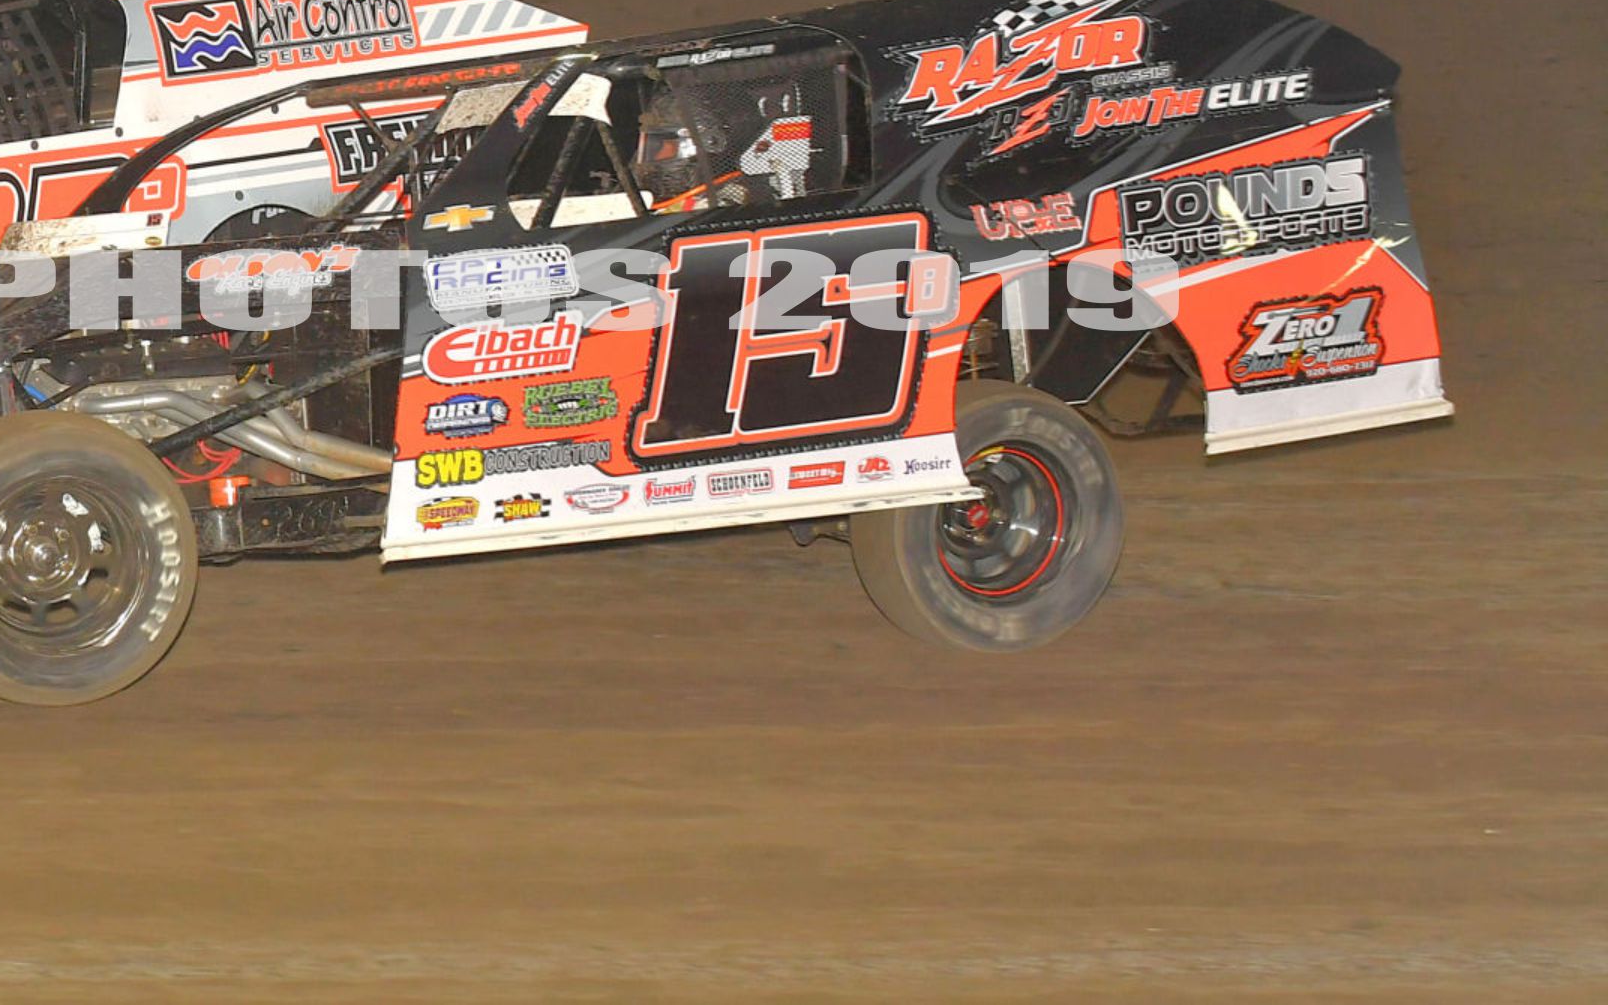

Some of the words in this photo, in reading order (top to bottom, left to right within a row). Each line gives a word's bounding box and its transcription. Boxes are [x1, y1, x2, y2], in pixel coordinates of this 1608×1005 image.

[258, 33, 416, 66] SERVICES
[1206, 72, 1311, 112] ELITE
[1121, 158, 1368, 235] POUNDS
[434, 264, 567, 291] RACING
[427, 315, 577, 378] Eibach
[427, 401, 489, 420] DIRT
[416, 448, 485, 488] SWB
[484, 441, 611, 475] CONSTRUCTION
[503, 501, 542, 519] SHAW
